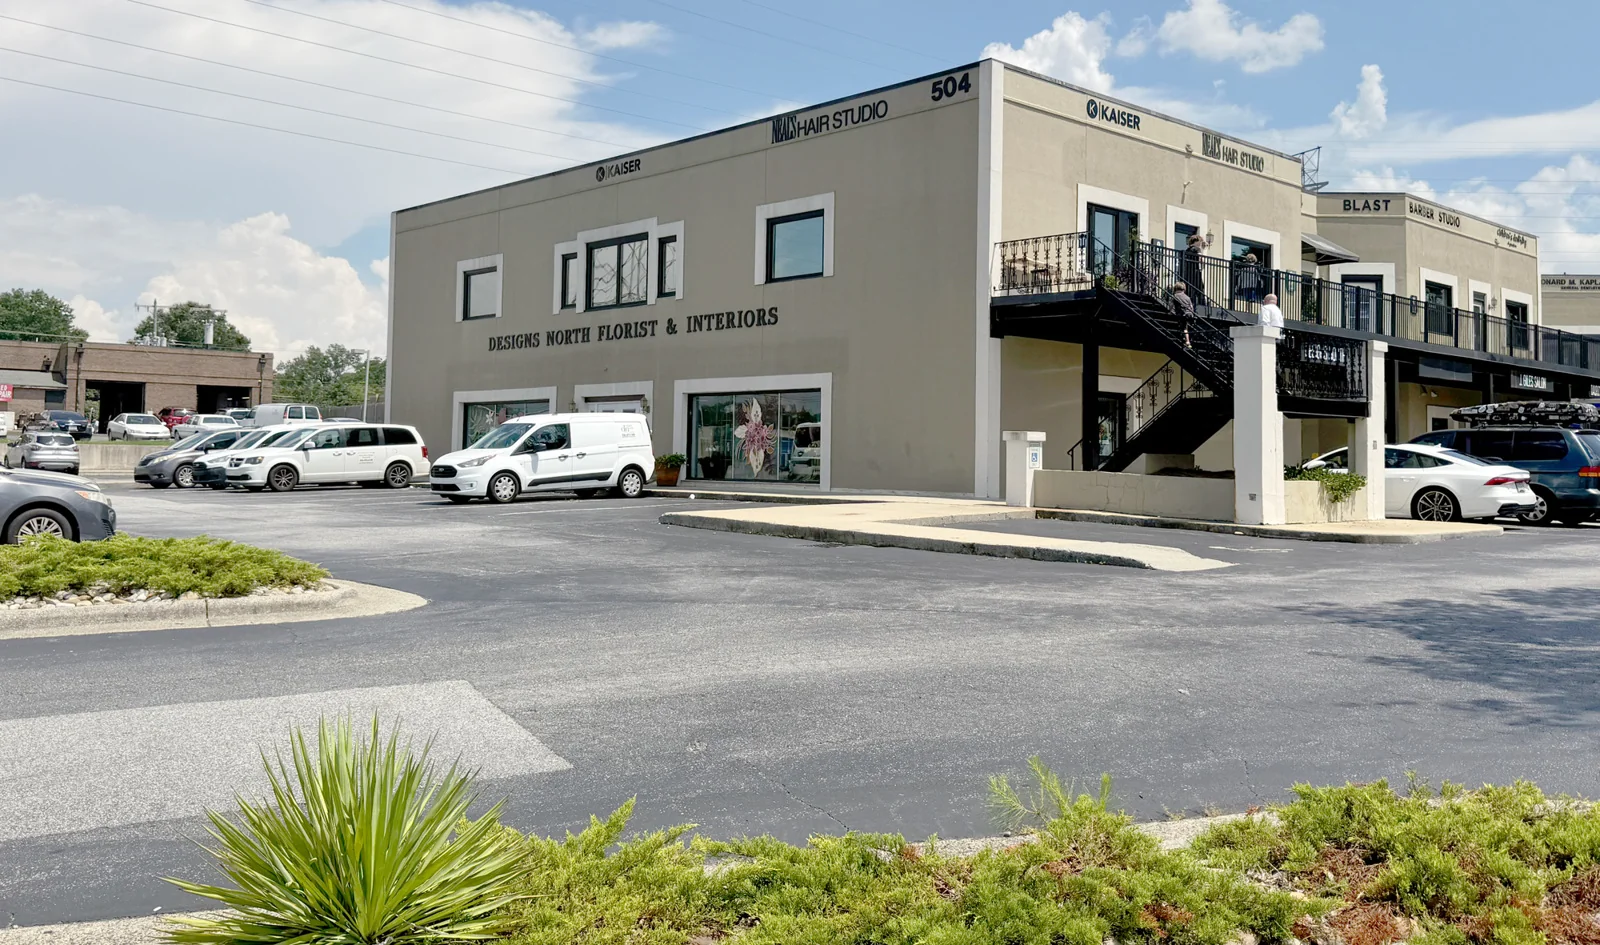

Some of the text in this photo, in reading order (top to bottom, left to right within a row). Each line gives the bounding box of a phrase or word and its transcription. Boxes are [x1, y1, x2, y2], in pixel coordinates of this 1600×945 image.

[931, 72, 971, 102] 504
[797, 114, 829, 138] HAIR
[832, 100, 889, 129] STUDIO
[1102, 105, 1140, 131] KAISER
[608, 159, 641, 178] KAISER
[1222, 146, 1238, 165] HAIR
[1240, 151, 1264, 172] STUDIO
[1343, 199, 1390, 212] BLAST
[1409, 202, 1461, 228] BARBER STUDIO
[488, 307, 779, 351] DESIGNS NORTH FLORIST & INTERIORS
